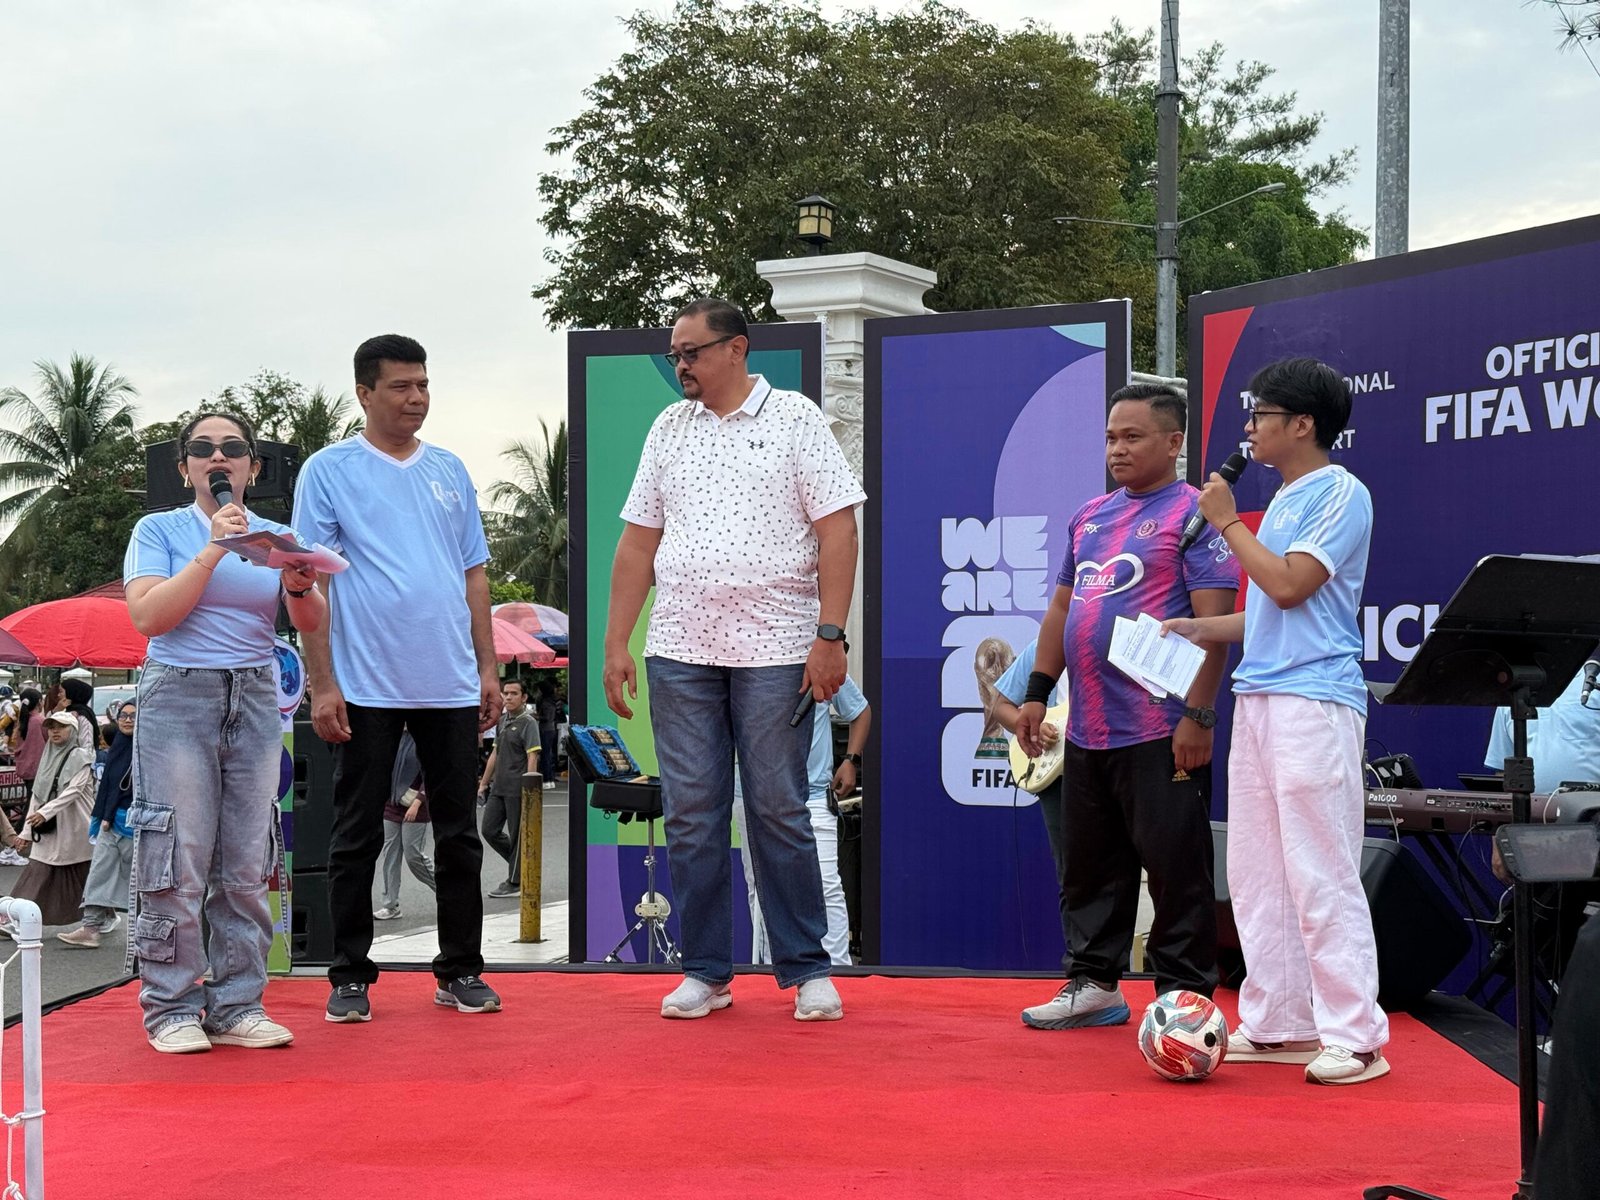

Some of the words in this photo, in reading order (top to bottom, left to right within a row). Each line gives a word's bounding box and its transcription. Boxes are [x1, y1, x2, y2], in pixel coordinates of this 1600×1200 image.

[1425, 385, 1532, 443] FIFA
[941, 516, 1048, 570] WE
[1081, 574, 1116, 586] FILMA
[972, 768, 1017, 788] FIFA
[1368, 793, 1397, 802] Pa1000
